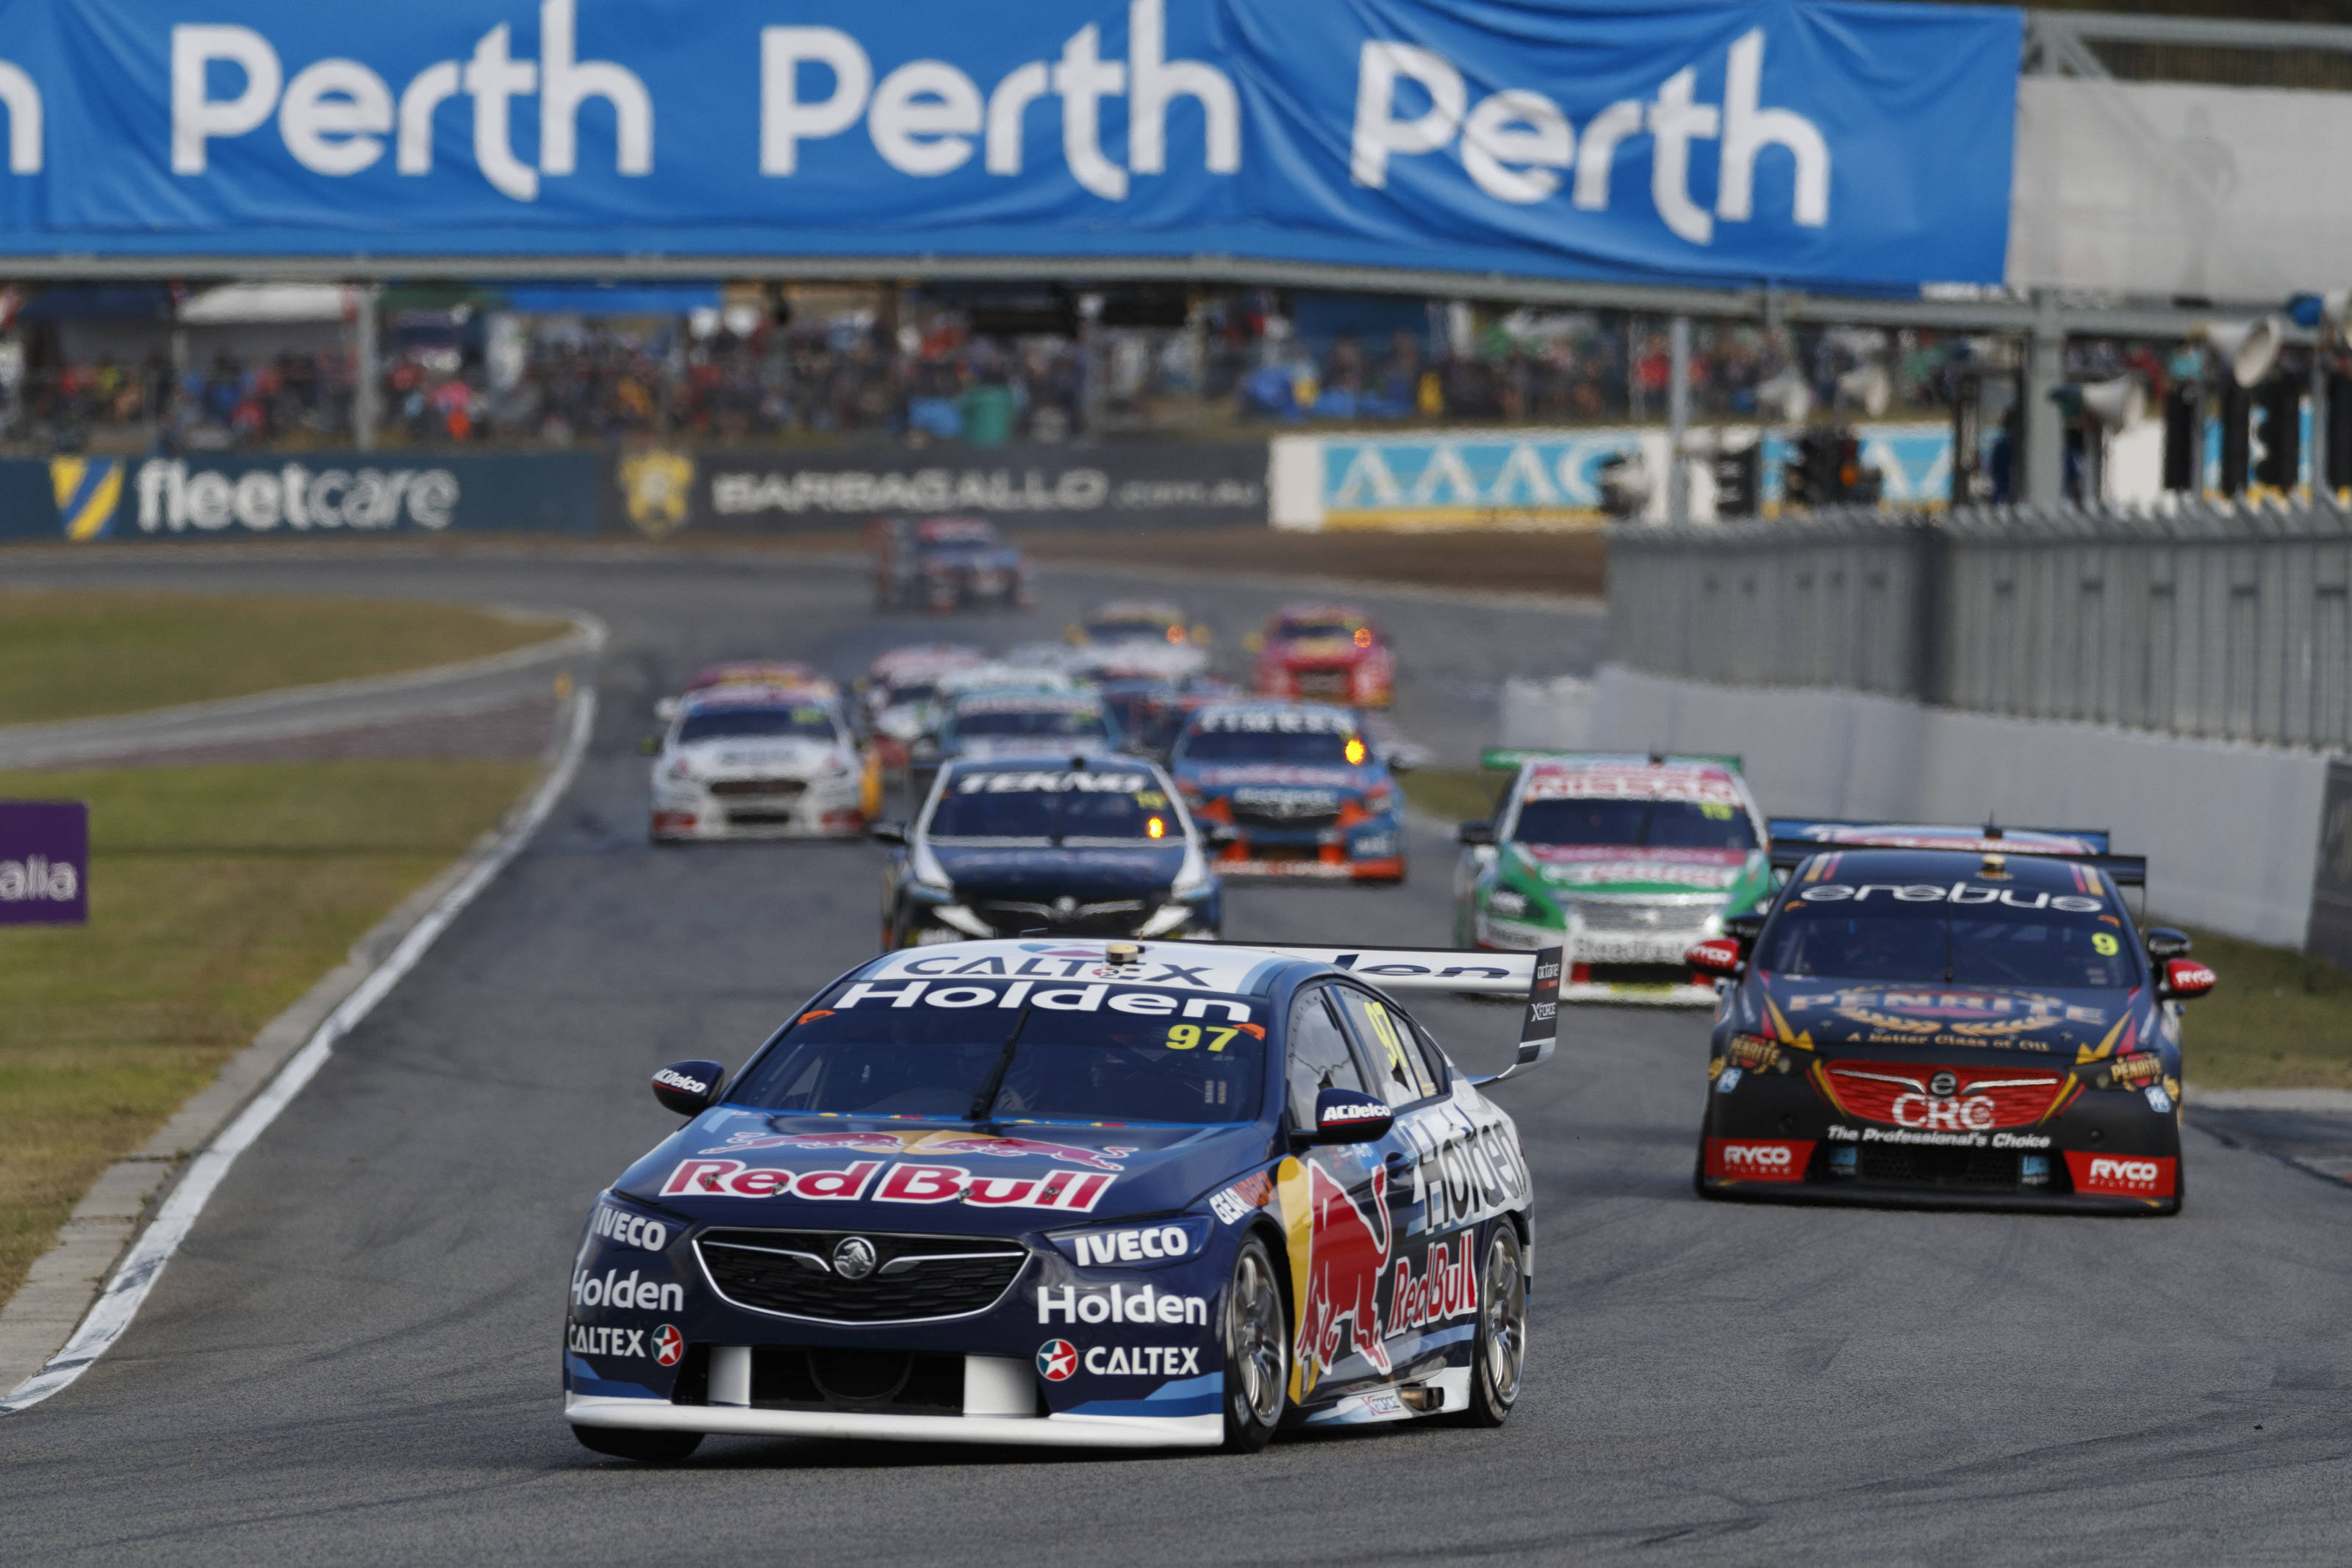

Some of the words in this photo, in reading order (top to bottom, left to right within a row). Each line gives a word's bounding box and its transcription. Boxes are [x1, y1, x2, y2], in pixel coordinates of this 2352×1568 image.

[170, 0, 654, 201] Perth
[759, 0, 1242, 201] Perth
[1350, 26, 1831, 245] Perth
[137, 457, 459, 532] fleetcare
[713, 468, 1109, 514] BARBAGALLO
[958, 772, 1147, 794] TEKNO
[1801, 882, 2103, 913] erebus
[2091, 932, 2119, 956] 9
[903, 955, 1215, 988] CALTEX
[833, 981, 1252, 1023] Holden
[1789, 992, 2107, 1025] PENRITE
[1166, 1024, 1239, 1052] 97
[1846, 1032, 1862, 1042] A
[1934, 1033, 1987, 1047] Class
[1323, 1102, 1391, 1122] ACDelco
[1892, 1092, 1994, 1131] CRC
[1827, 1125, 1858, 1140] The
[1862, 1127, 1987, 1147] Professional's
[1992, 1132, 2051, 1148] Choice
[1724, 1145, 1791, 1165] RYCO
[2090, 1158, 2158, 1182] RYCO
[596, 1207, 666, 1251] IVECO
[1075, 1227, 1188, 1267] IVECO
[571, 1269, 684, 1312] Holden
[1037, 1284, 1207, 1326] Holden
[568, 1324, 646, 1358] CALTEX
[1084, 1347, 1200, 1375] CALTEX
